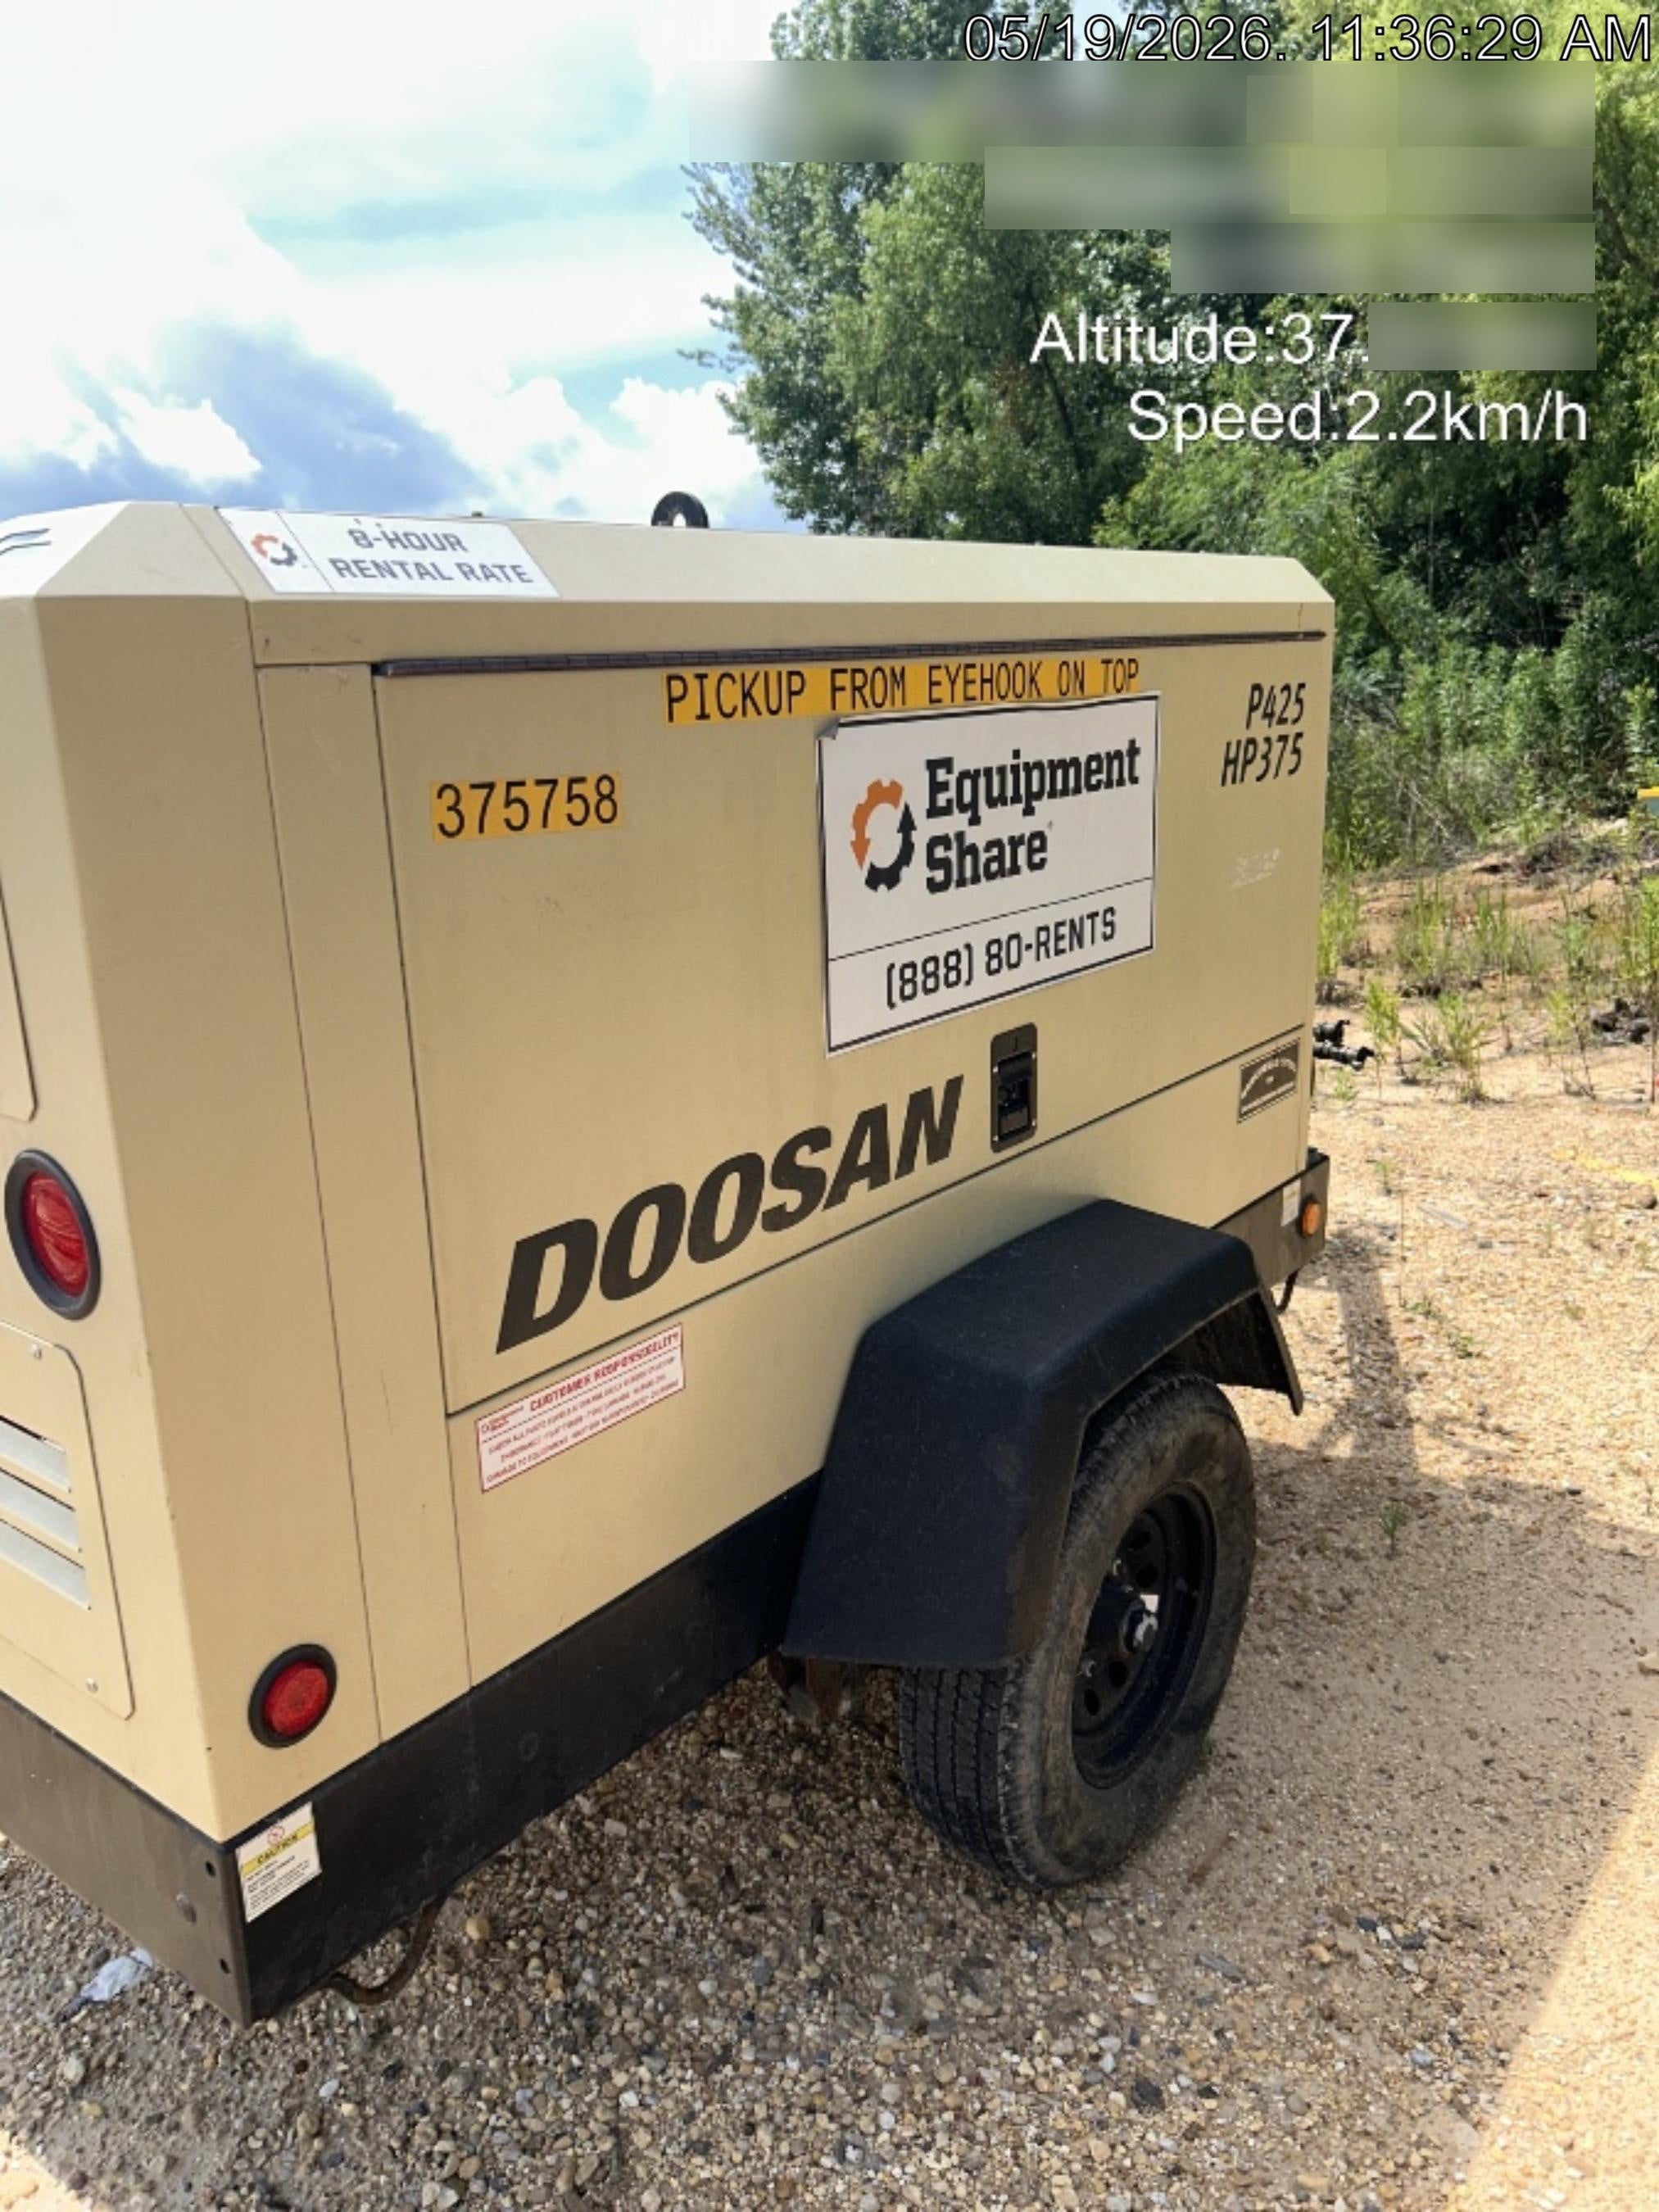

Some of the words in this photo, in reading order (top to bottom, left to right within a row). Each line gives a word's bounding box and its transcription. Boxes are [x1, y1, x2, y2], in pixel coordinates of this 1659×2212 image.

[329, 557, 453, 582] RENTAL
[454, 562, 534, 583] RATE
[347, 528, 469, 554] 8-HOUR
[665, 669, 807, 723] PICKUP
[829, 666, 906, 711] FROM
[927, 660, 1043, 705] EYEHOOK
[1058, 660, 1086, 696] ON
[1101, 658, 1140, 693] TOP
[1246, 682, 1307, 730] P425
[926, 737, 1141, 827] Equipment
[1221, 732, 1304, 787] HP375
[436, 773, 619, 839] 375758
[926, 830, 1049, 895] Share
[886, 942, 975, 1010] (888)
[985, 906, 1117, 977] 80-RENTS
[495, 1073, 964, 1355] DOOSAN
